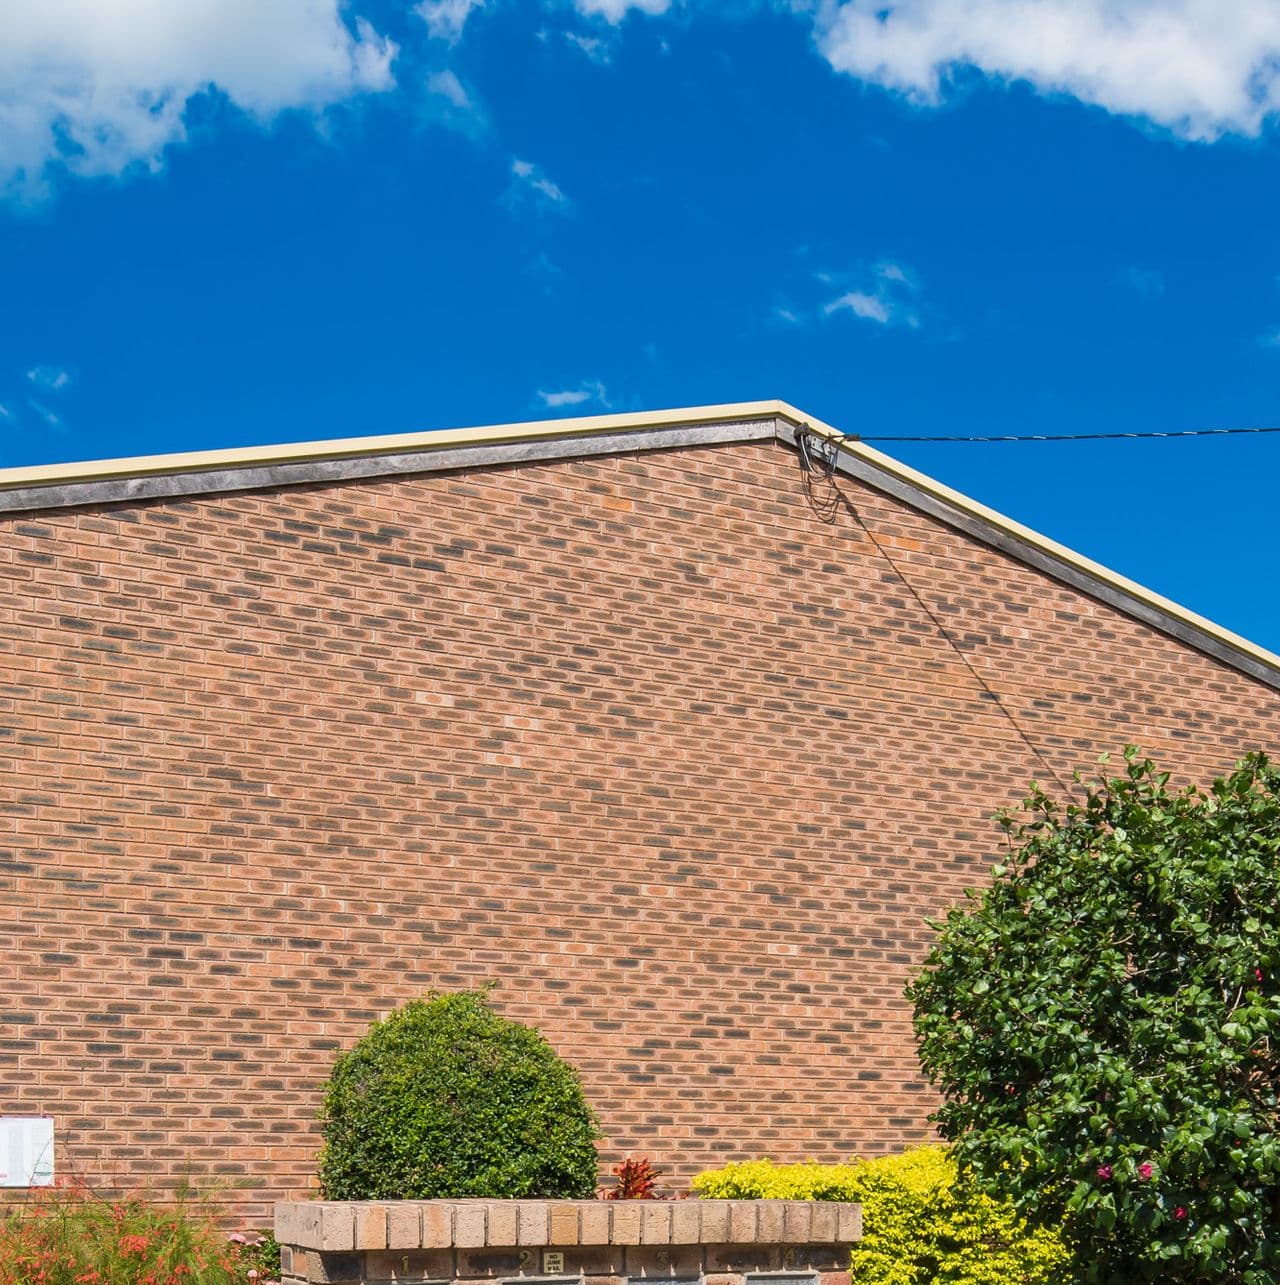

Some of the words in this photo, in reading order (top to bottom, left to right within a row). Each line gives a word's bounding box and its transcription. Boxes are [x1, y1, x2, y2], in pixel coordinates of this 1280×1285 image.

[401, 1255, 410, 1276] 1
[519, 1250, 533, 1271] 2
[784, 1248, 796, 1267] 4
